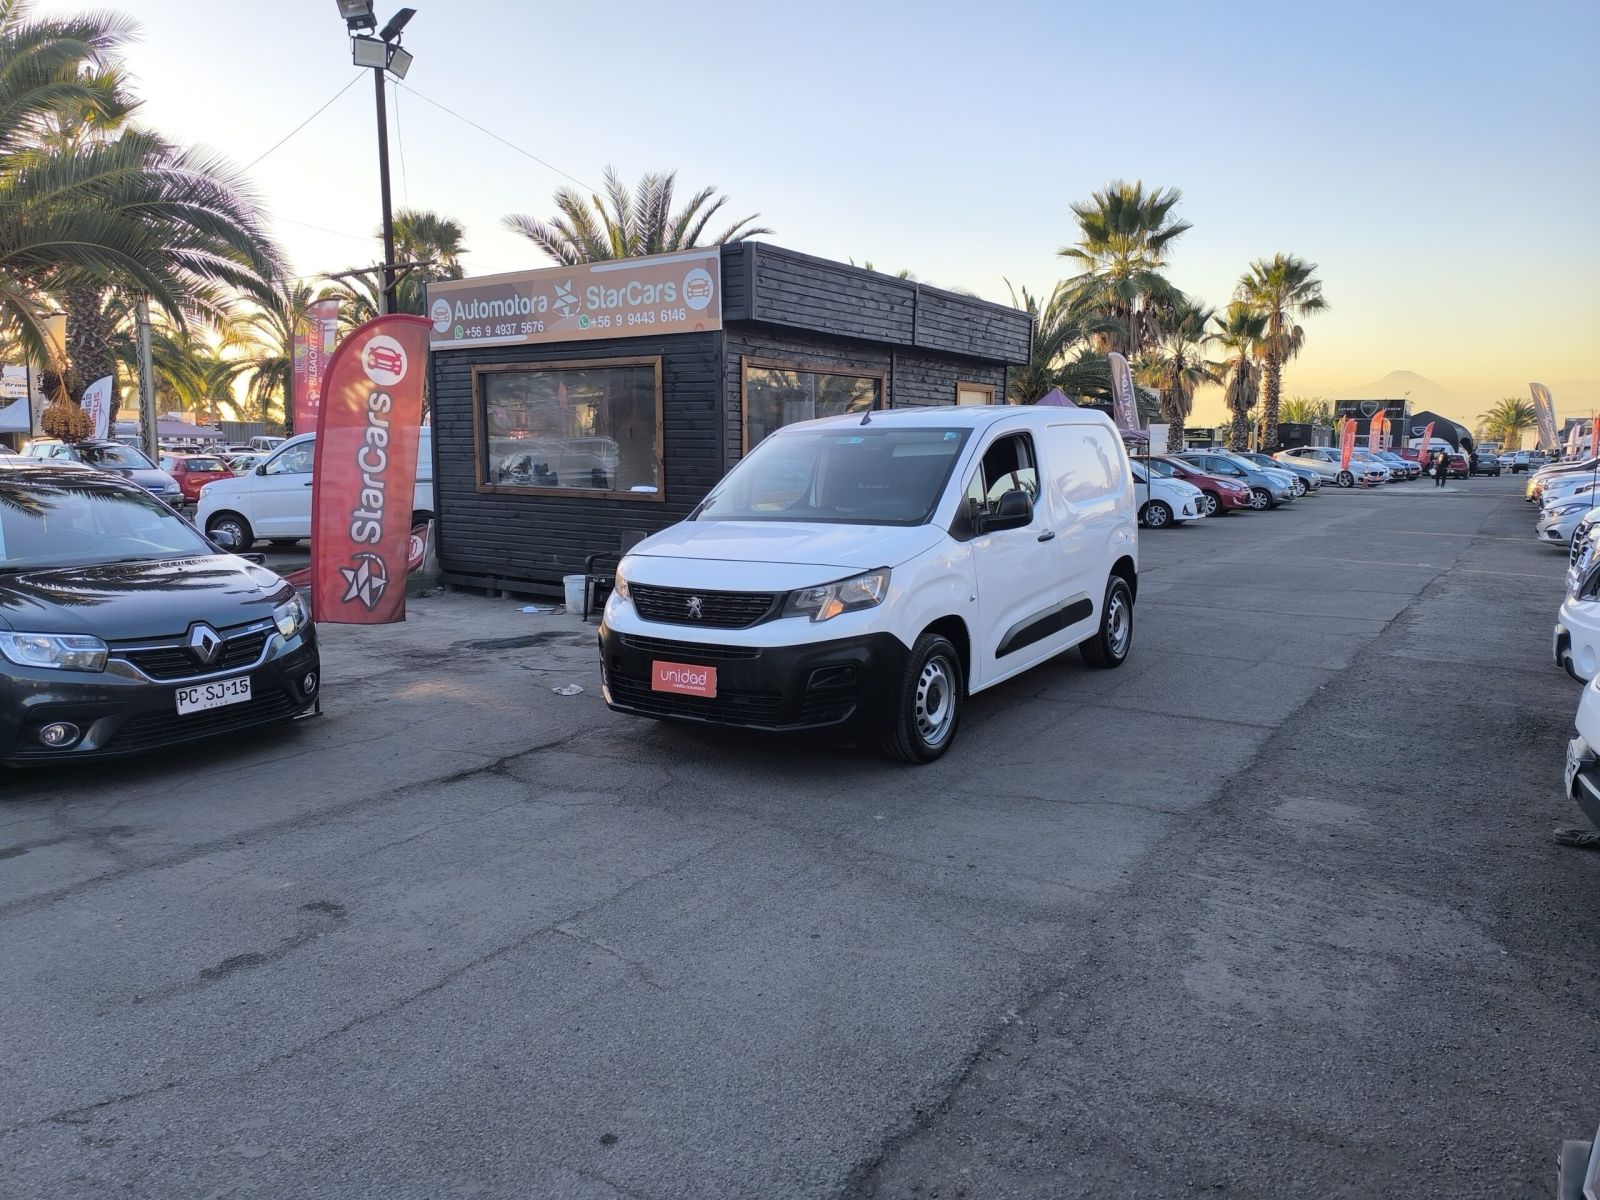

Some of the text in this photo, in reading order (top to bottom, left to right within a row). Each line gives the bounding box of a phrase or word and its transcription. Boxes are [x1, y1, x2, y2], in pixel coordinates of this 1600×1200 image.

[454, 280, 677, 321] Automotora StarCars
[590, 308, 686, 328] +56 9 9443 6146
[465, 320, 544, 338] +56 9 4937 5676
[351, 392, 391, 544] StarCars
[660, 669, 707, 686] unidad
